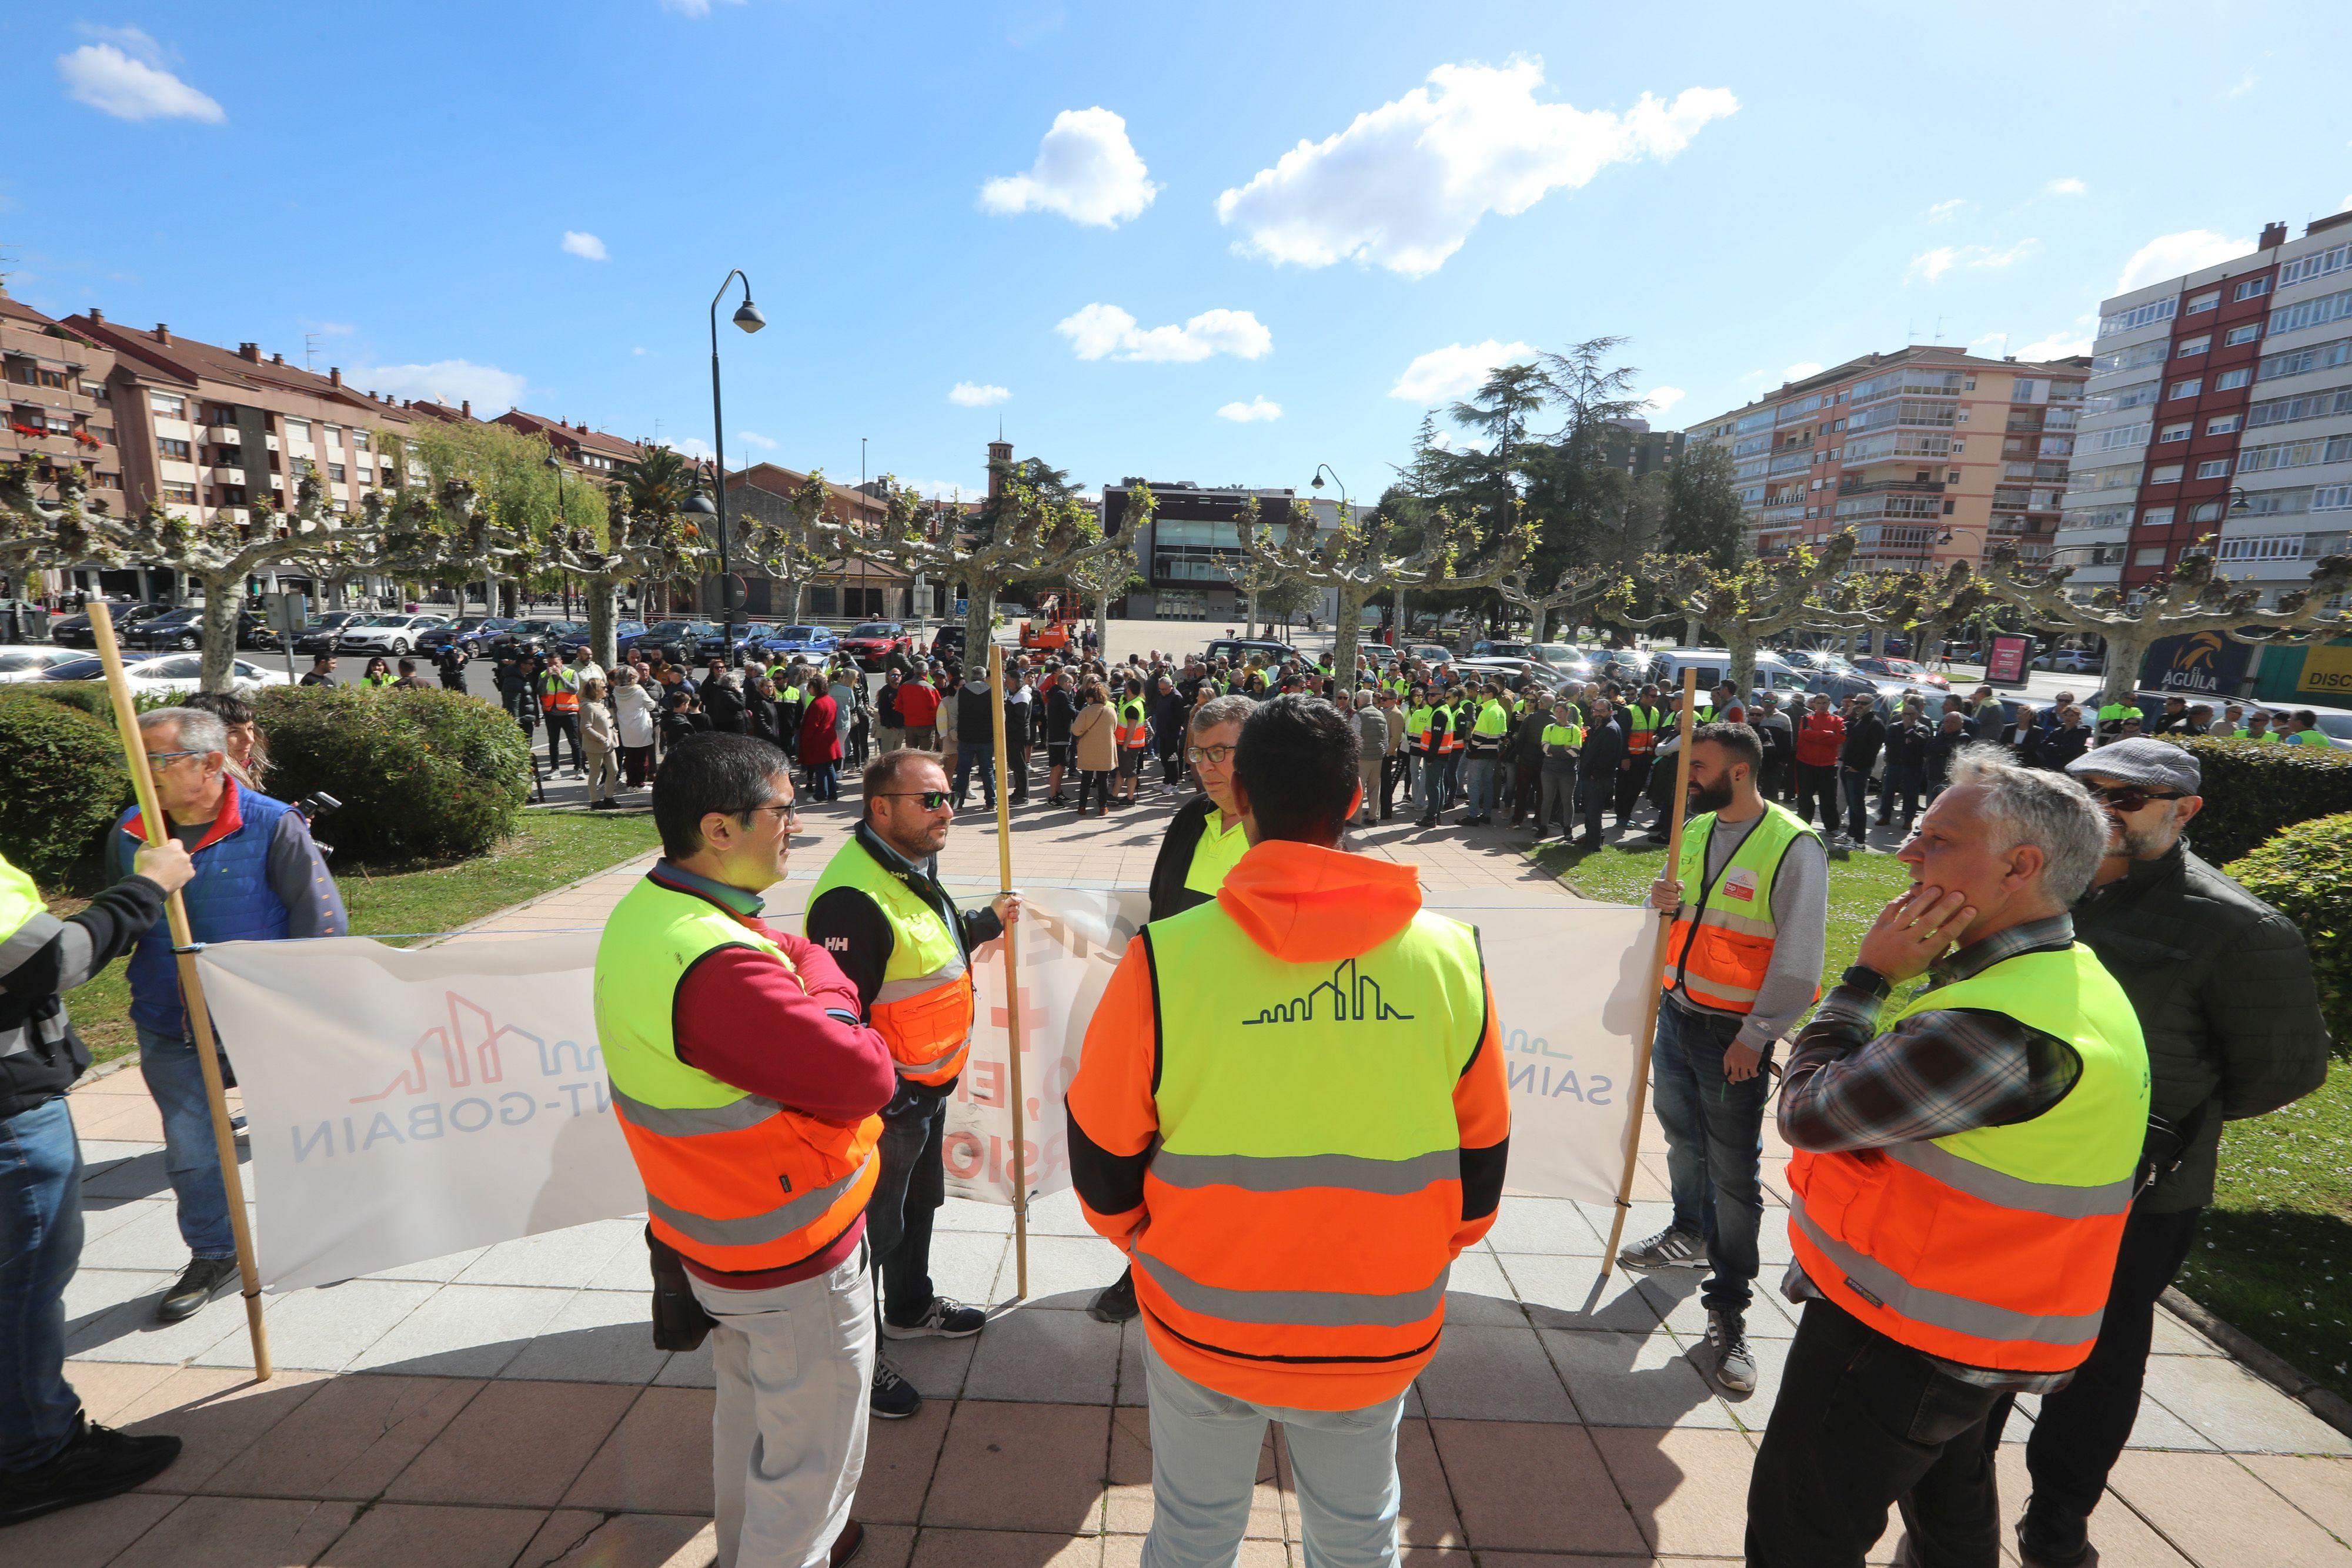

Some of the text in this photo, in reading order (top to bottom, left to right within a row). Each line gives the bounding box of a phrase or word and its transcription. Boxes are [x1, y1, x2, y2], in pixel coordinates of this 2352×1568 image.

[2191, 667, 2201, 675] EL
[2161, 669, 2217, 691] ÁGUILA
[2308, 672, 2352, 687] DISC
[824, 937, 848, 951] HH
